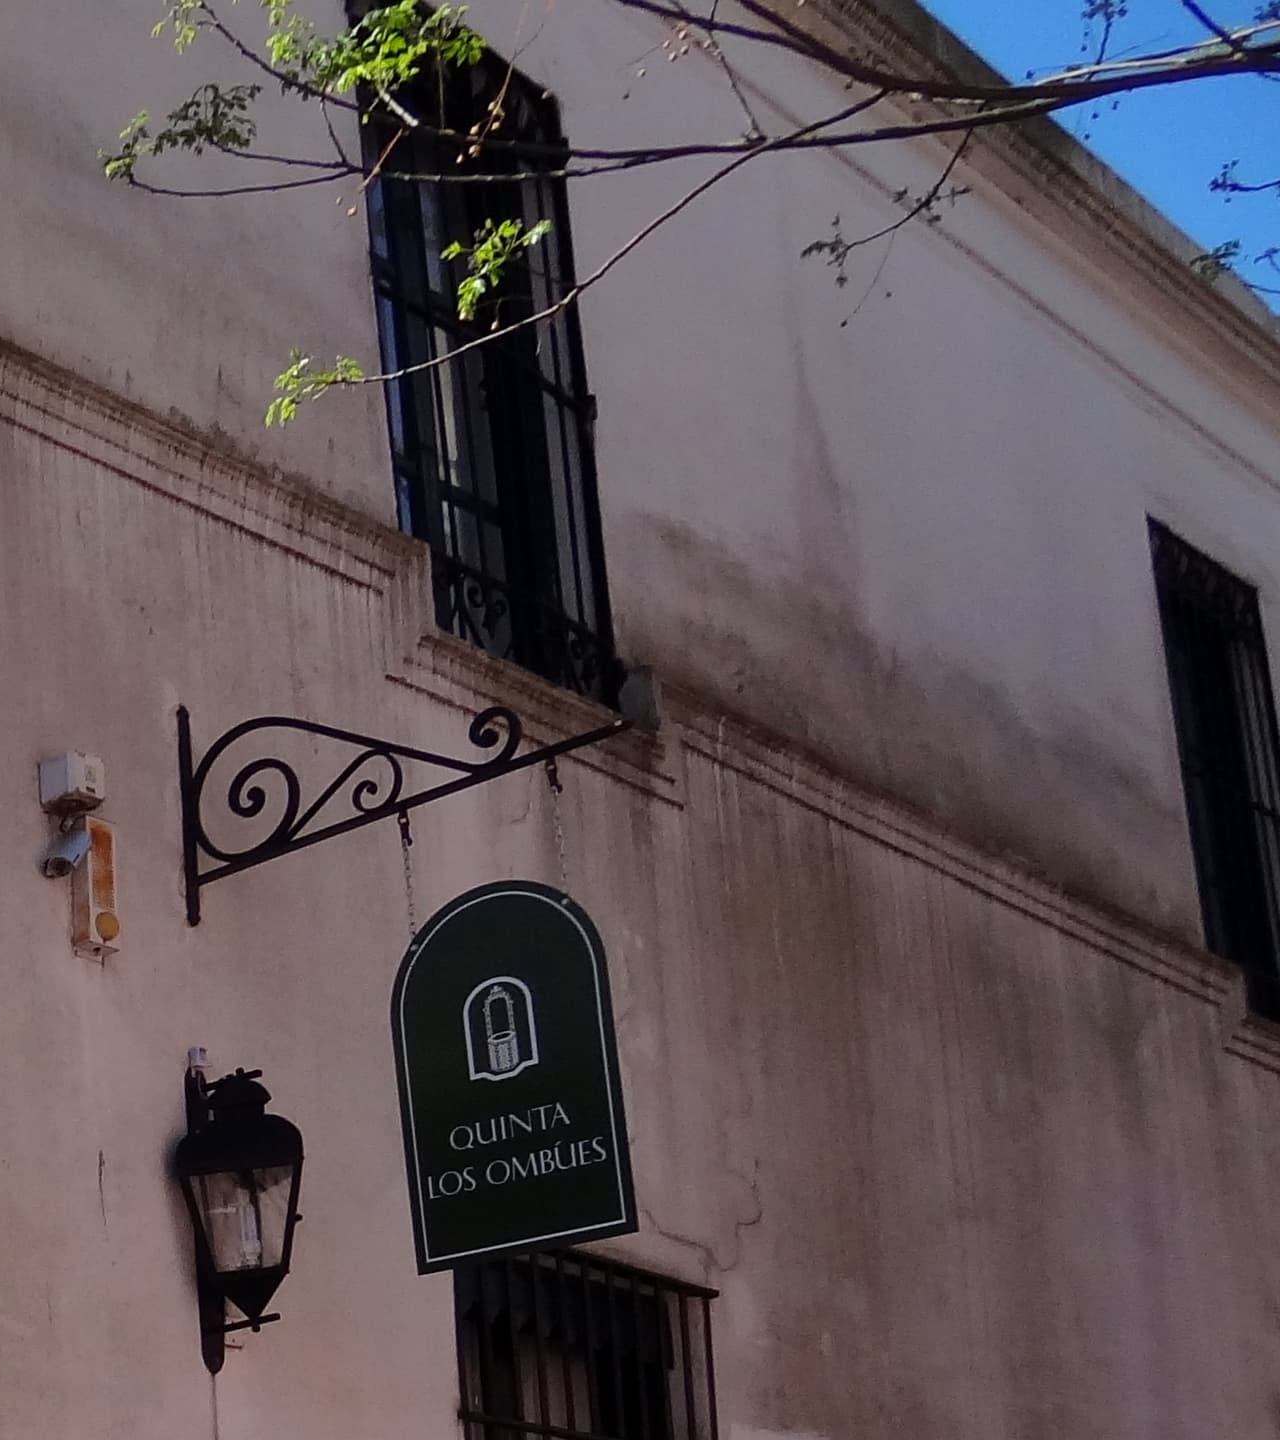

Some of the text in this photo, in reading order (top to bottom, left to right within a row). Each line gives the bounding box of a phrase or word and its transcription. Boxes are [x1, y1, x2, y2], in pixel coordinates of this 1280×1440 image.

[449, 1101, 571, 1150] QUINTA
[427, 1136, 607, 1200] LOS OMBÚES
